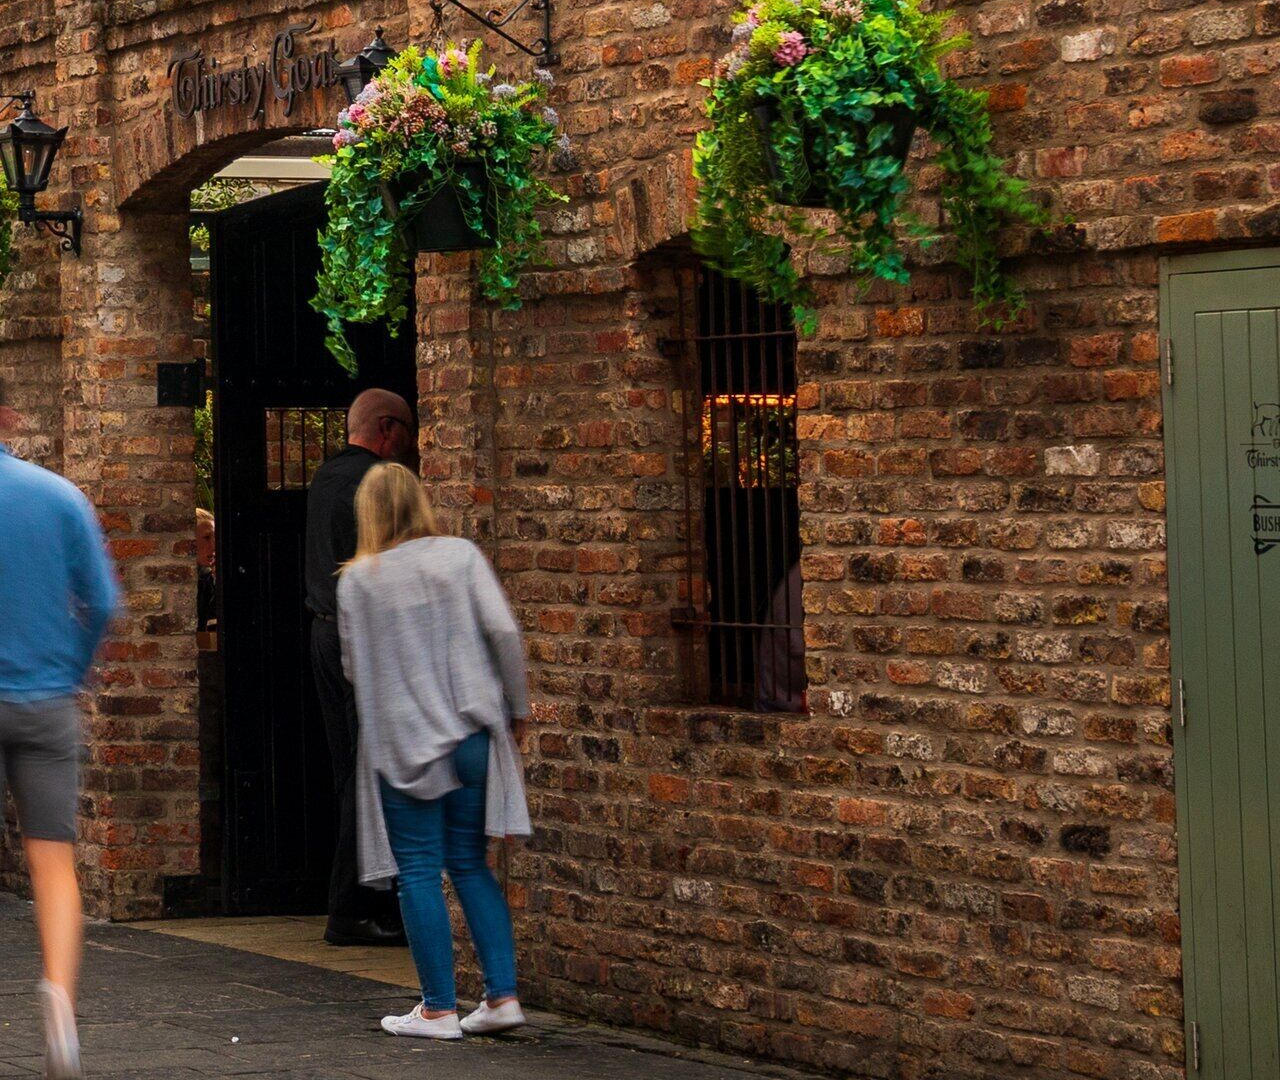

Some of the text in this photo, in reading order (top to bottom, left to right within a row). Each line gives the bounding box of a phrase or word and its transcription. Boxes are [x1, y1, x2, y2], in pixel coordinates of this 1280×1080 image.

[168, 19, 340, 120] Thirsty Goat
[1246, 449, 1280, 472] Thirst
